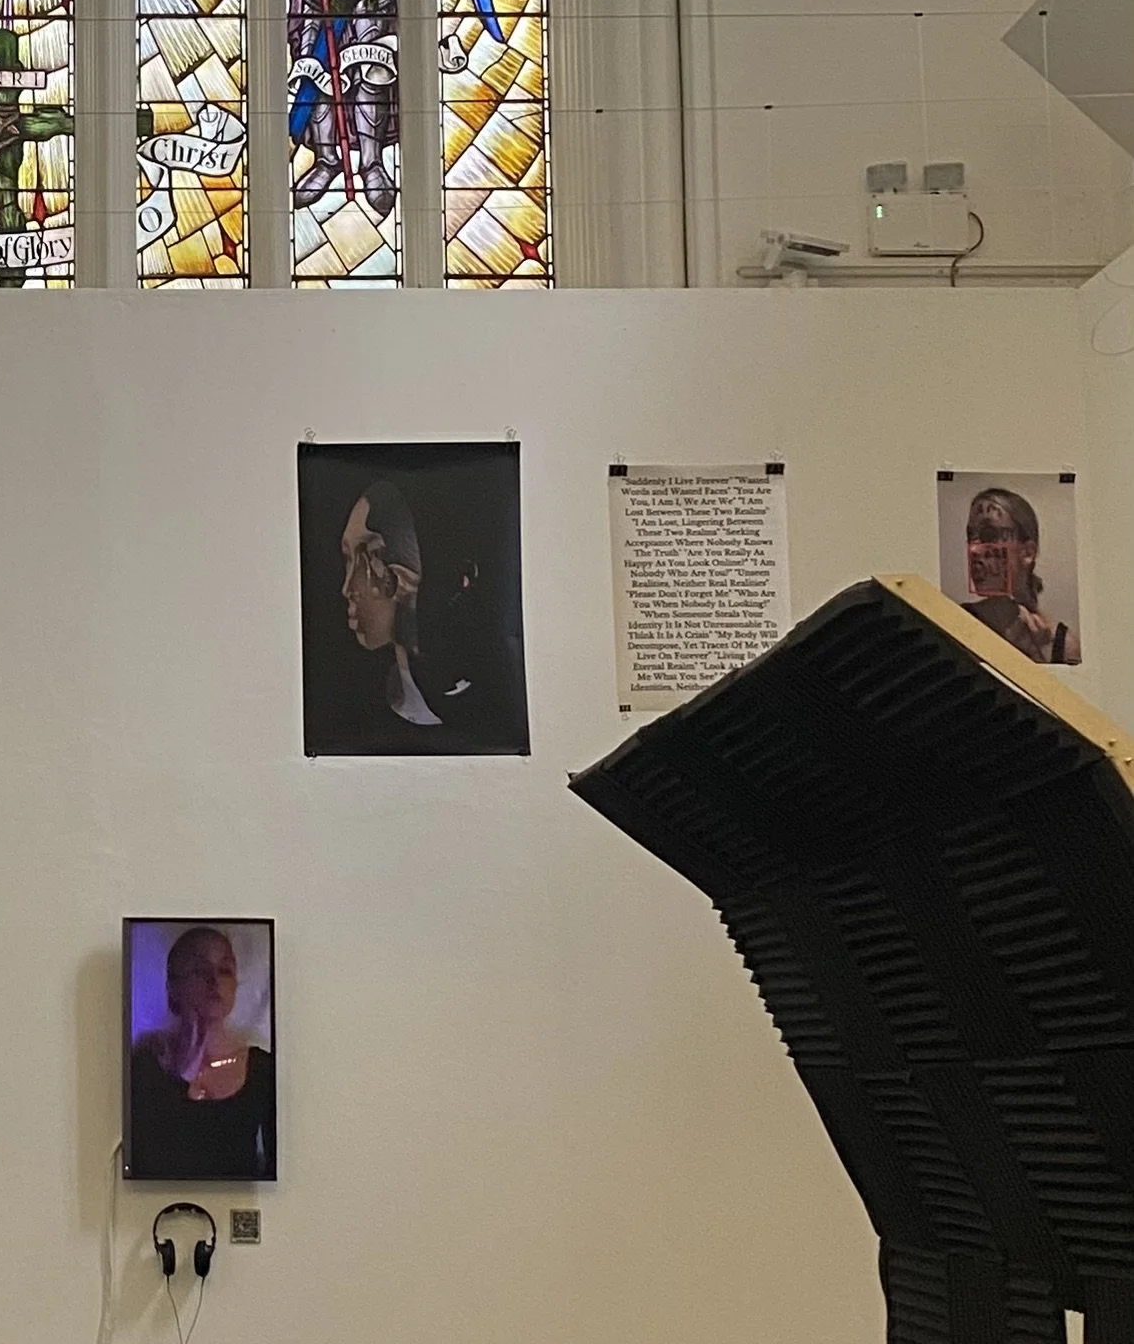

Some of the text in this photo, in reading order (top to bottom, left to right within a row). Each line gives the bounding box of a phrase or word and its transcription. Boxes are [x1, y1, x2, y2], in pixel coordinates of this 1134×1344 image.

[342, 47, 393, 65] GEORGE
[151, 138, 233, 170] Christ
[138, 206, 163, 233] O
[13, 235, 73, 259] Glory
